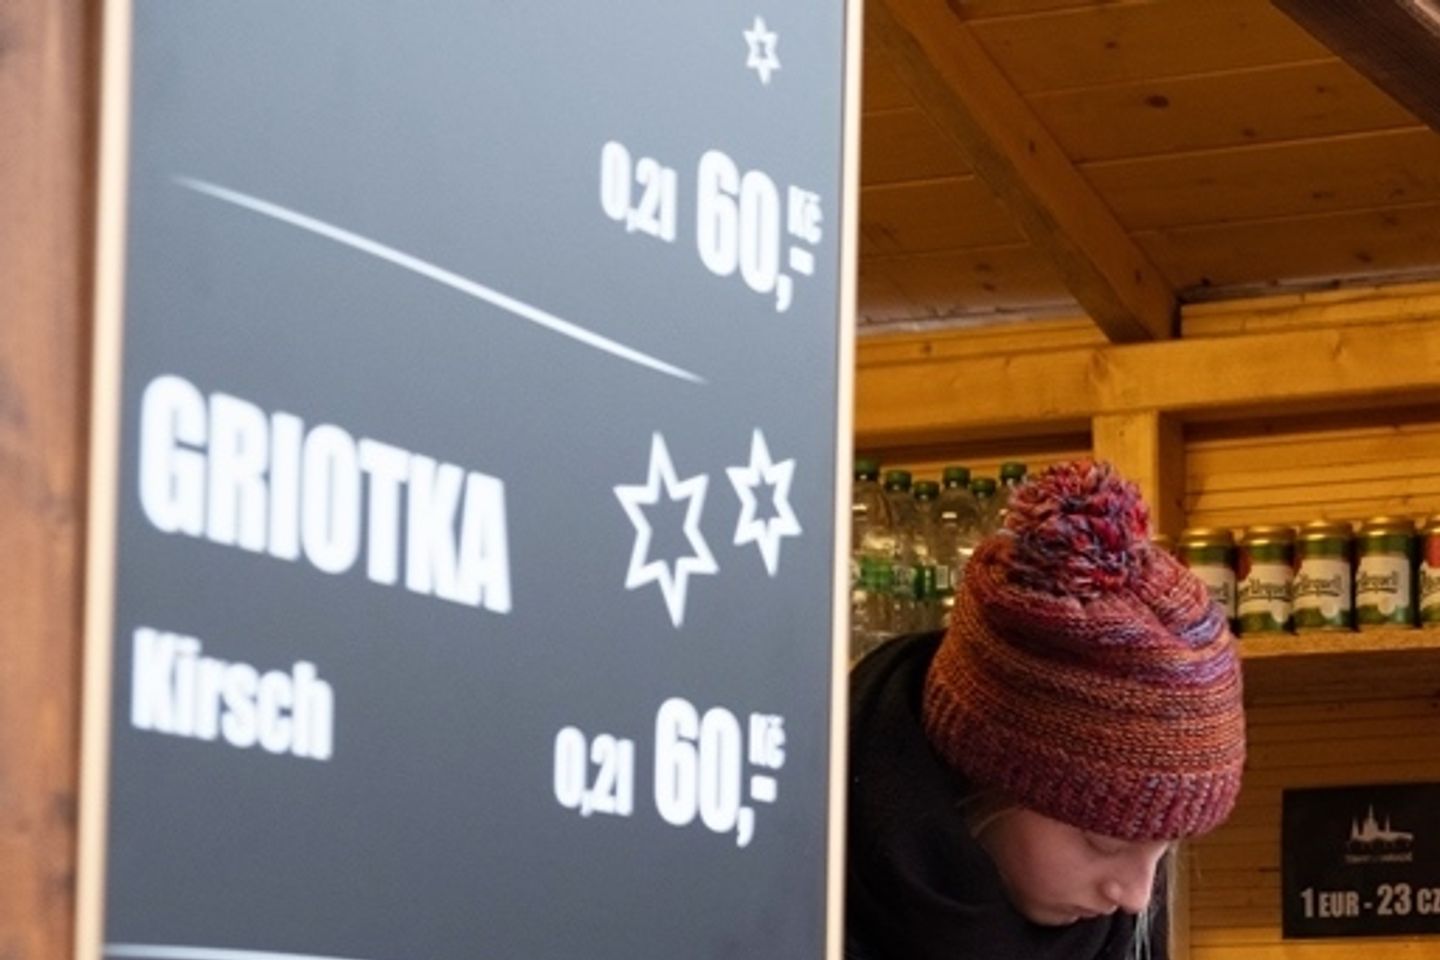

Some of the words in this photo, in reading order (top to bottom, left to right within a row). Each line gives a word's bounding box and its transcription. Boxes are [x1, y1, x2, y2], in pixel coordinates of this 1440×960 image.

[139, 375, 512, 615] GRIOTKA
[130, 627, 334, 761] Kirsch
[1301, 888, 1314, 917] 1
[1318, 889, 1360, 918] EUR
[1377, 883, 1411, 915] 23
